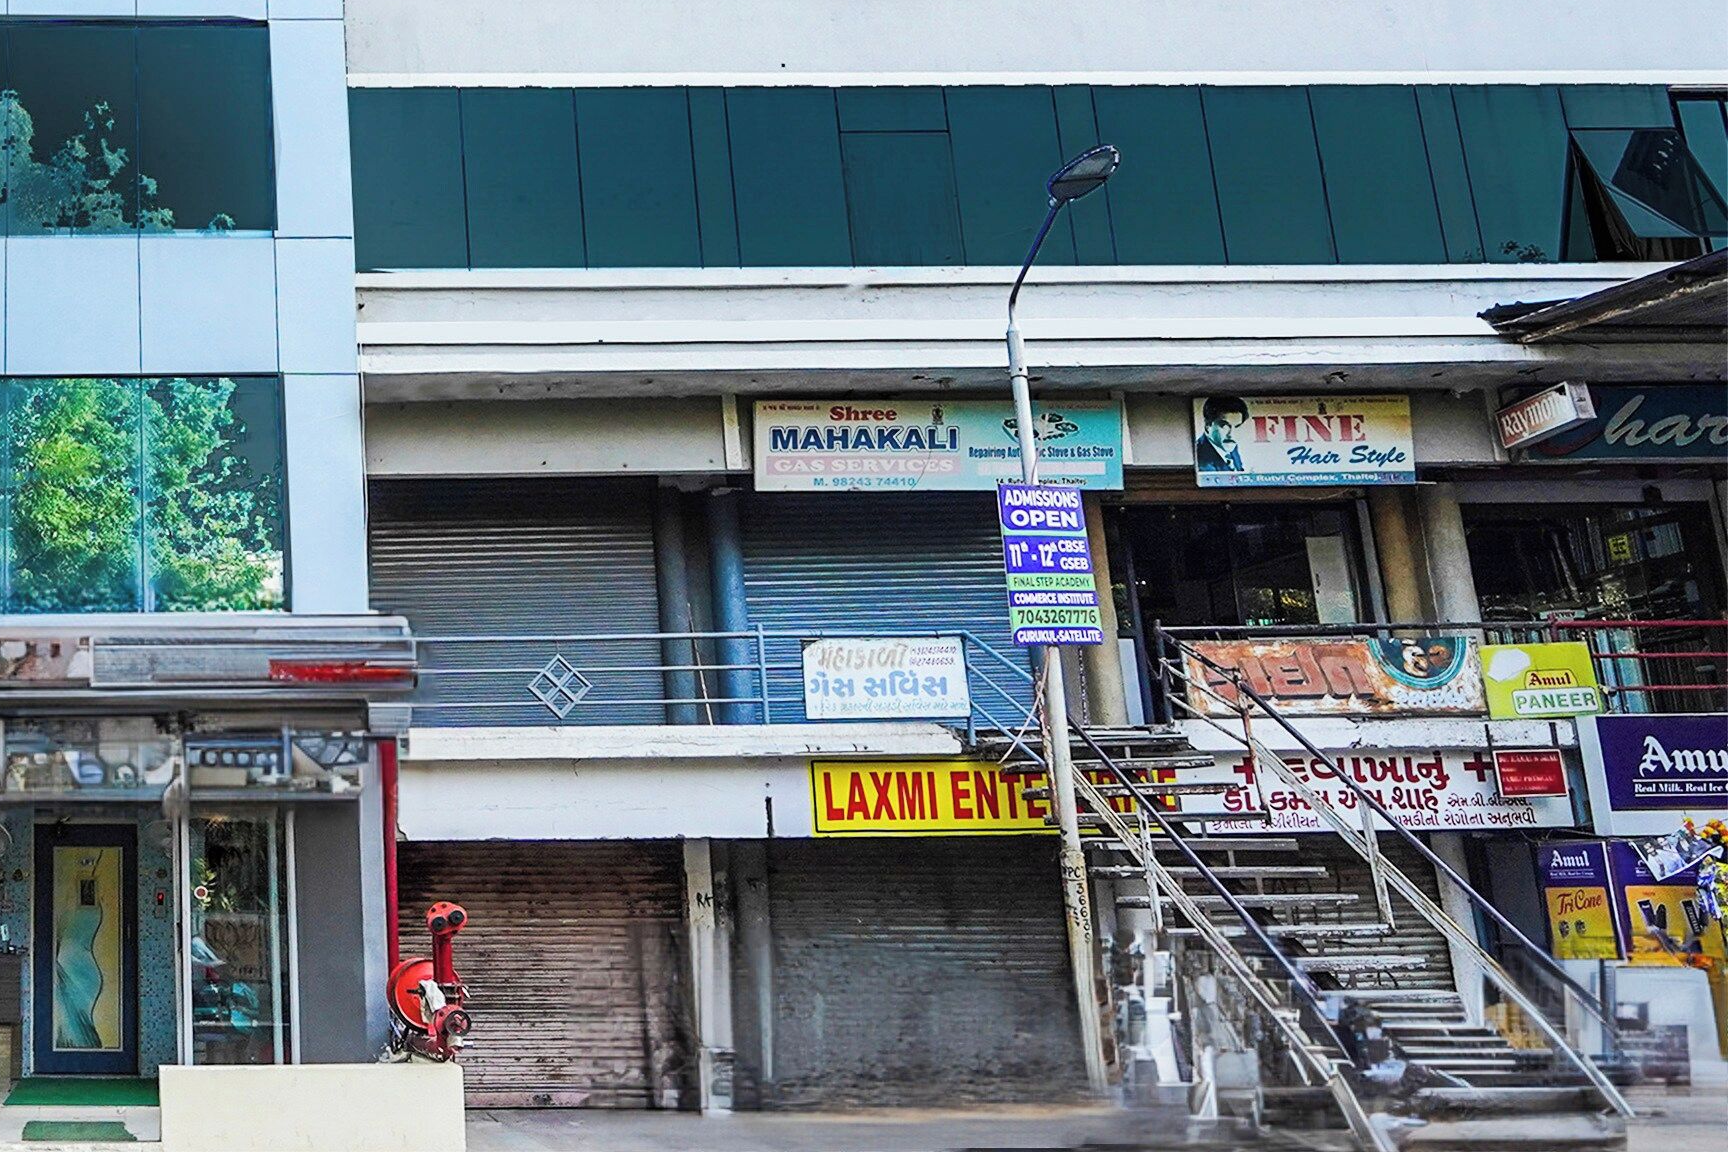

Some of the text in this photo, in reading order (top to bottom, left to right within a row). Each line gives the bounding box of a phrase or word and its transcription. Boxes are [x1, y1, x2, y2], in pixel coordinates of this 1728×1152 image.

[829, 405, 898, 421] Shree
[1252, 414, 1366, 443] FINE
[770, 425, 959, 452] MAHAKALI
[968, 447, 1007, 459] Repairing
[1047, 446, 1069, 458] Stove
[1077, 446, 1091, 458] Gas
[1093, 447, 1114, 458] Stove
[1287, 445, 1405, 467] Hair Style
[774, 459, 954, 473] GAS SERVICES
[813, 478, 915, 487] M. 98243 74410
[1005, 489, 1079, 508] ADMISSIONS
[1010, 509, 1079, 528] OPEN
[1058, 540, 1086, 553] CBSE
[1060, 557, 1089, 570] GSEB
[1014, 577, 1090, 587] FINAL STEP ACADEMY
[1014, 592, 1094, 604] COMMERCE INSTITUTE
[1018, 610, 1097, 623] 7043267776
[1529, 671, 1572, 687] Amul
[1516, 690, 1597, 712] PANEER
[824, 770, 938, 821] LAXMI
[1635, 783, 1656, 793] Real
[1659, 783, 1684, 792] Milk.
[1686, 783, 1707, 792] Real
[1709, 782, 1723, 792] Ice
[1550, 849, 1590, 867] Amul
